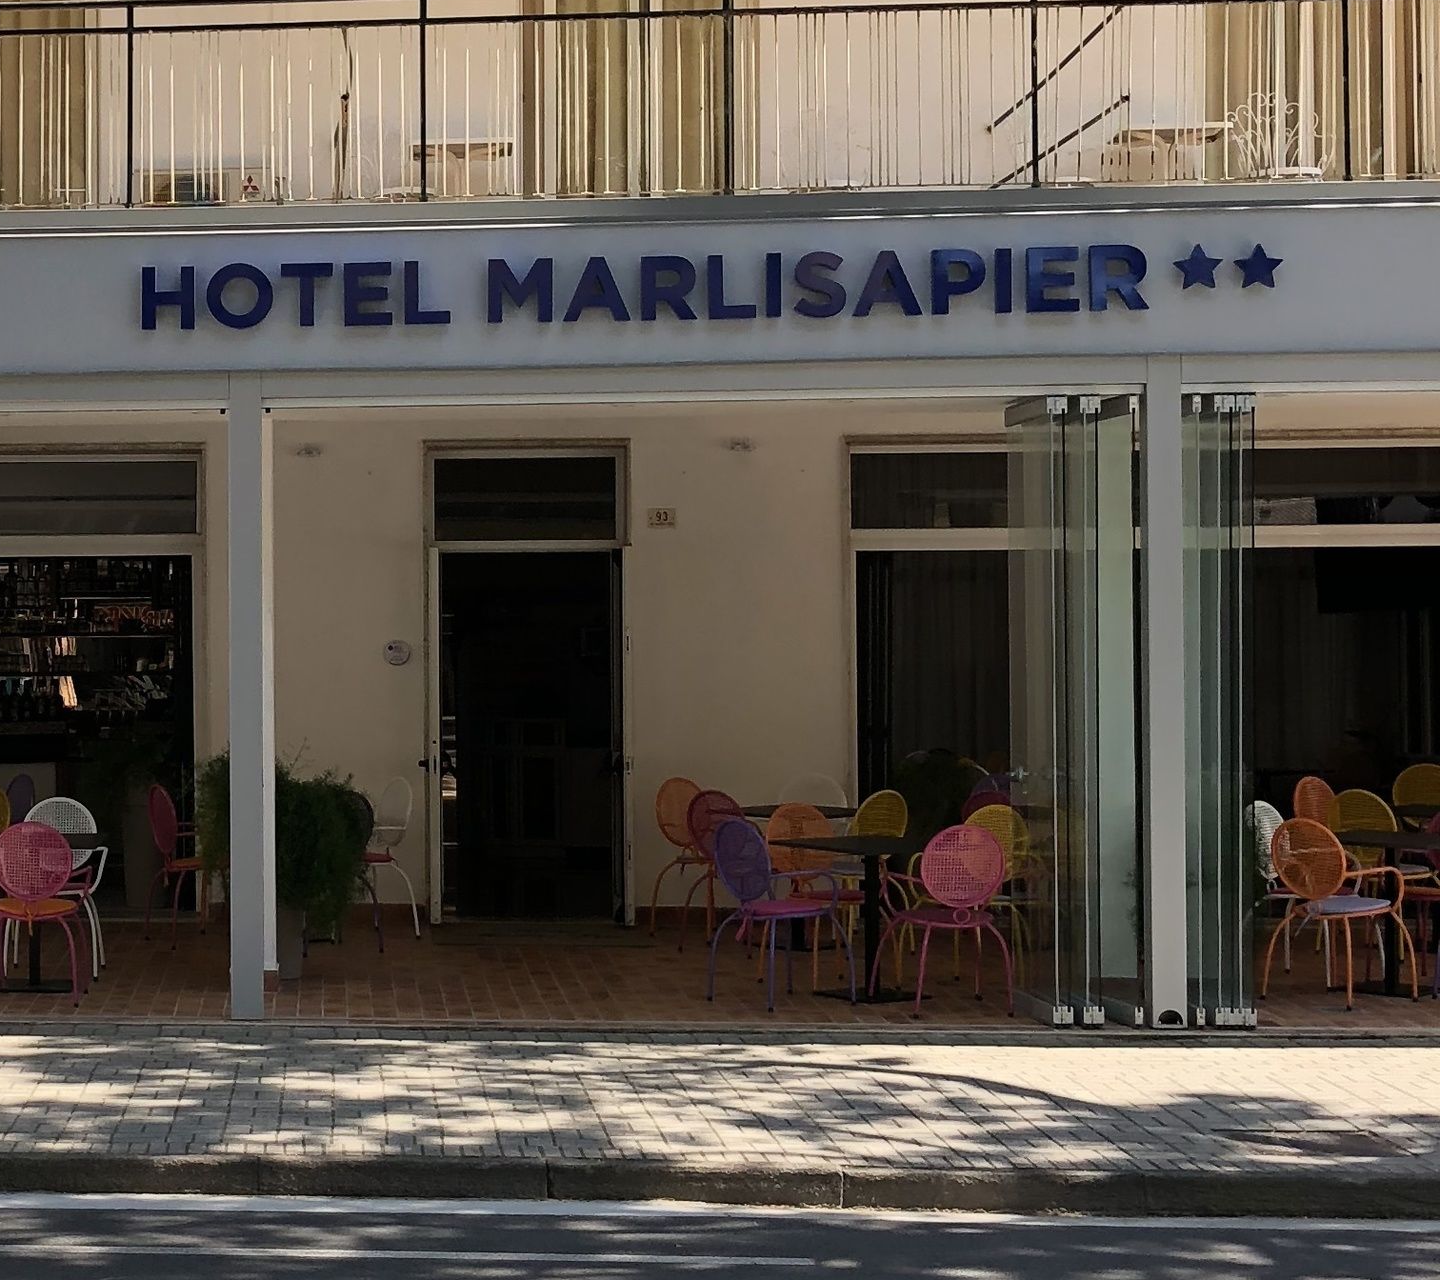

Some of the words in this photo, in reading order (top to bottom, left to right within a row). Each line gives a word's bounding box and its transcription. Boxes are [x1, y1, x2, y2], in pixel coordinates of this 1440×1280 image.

[141, 261, 451, 330] HOTEL
[487, 244, 1150, 322] MARLISAPIER
[656, 511, 668, 521] 93
